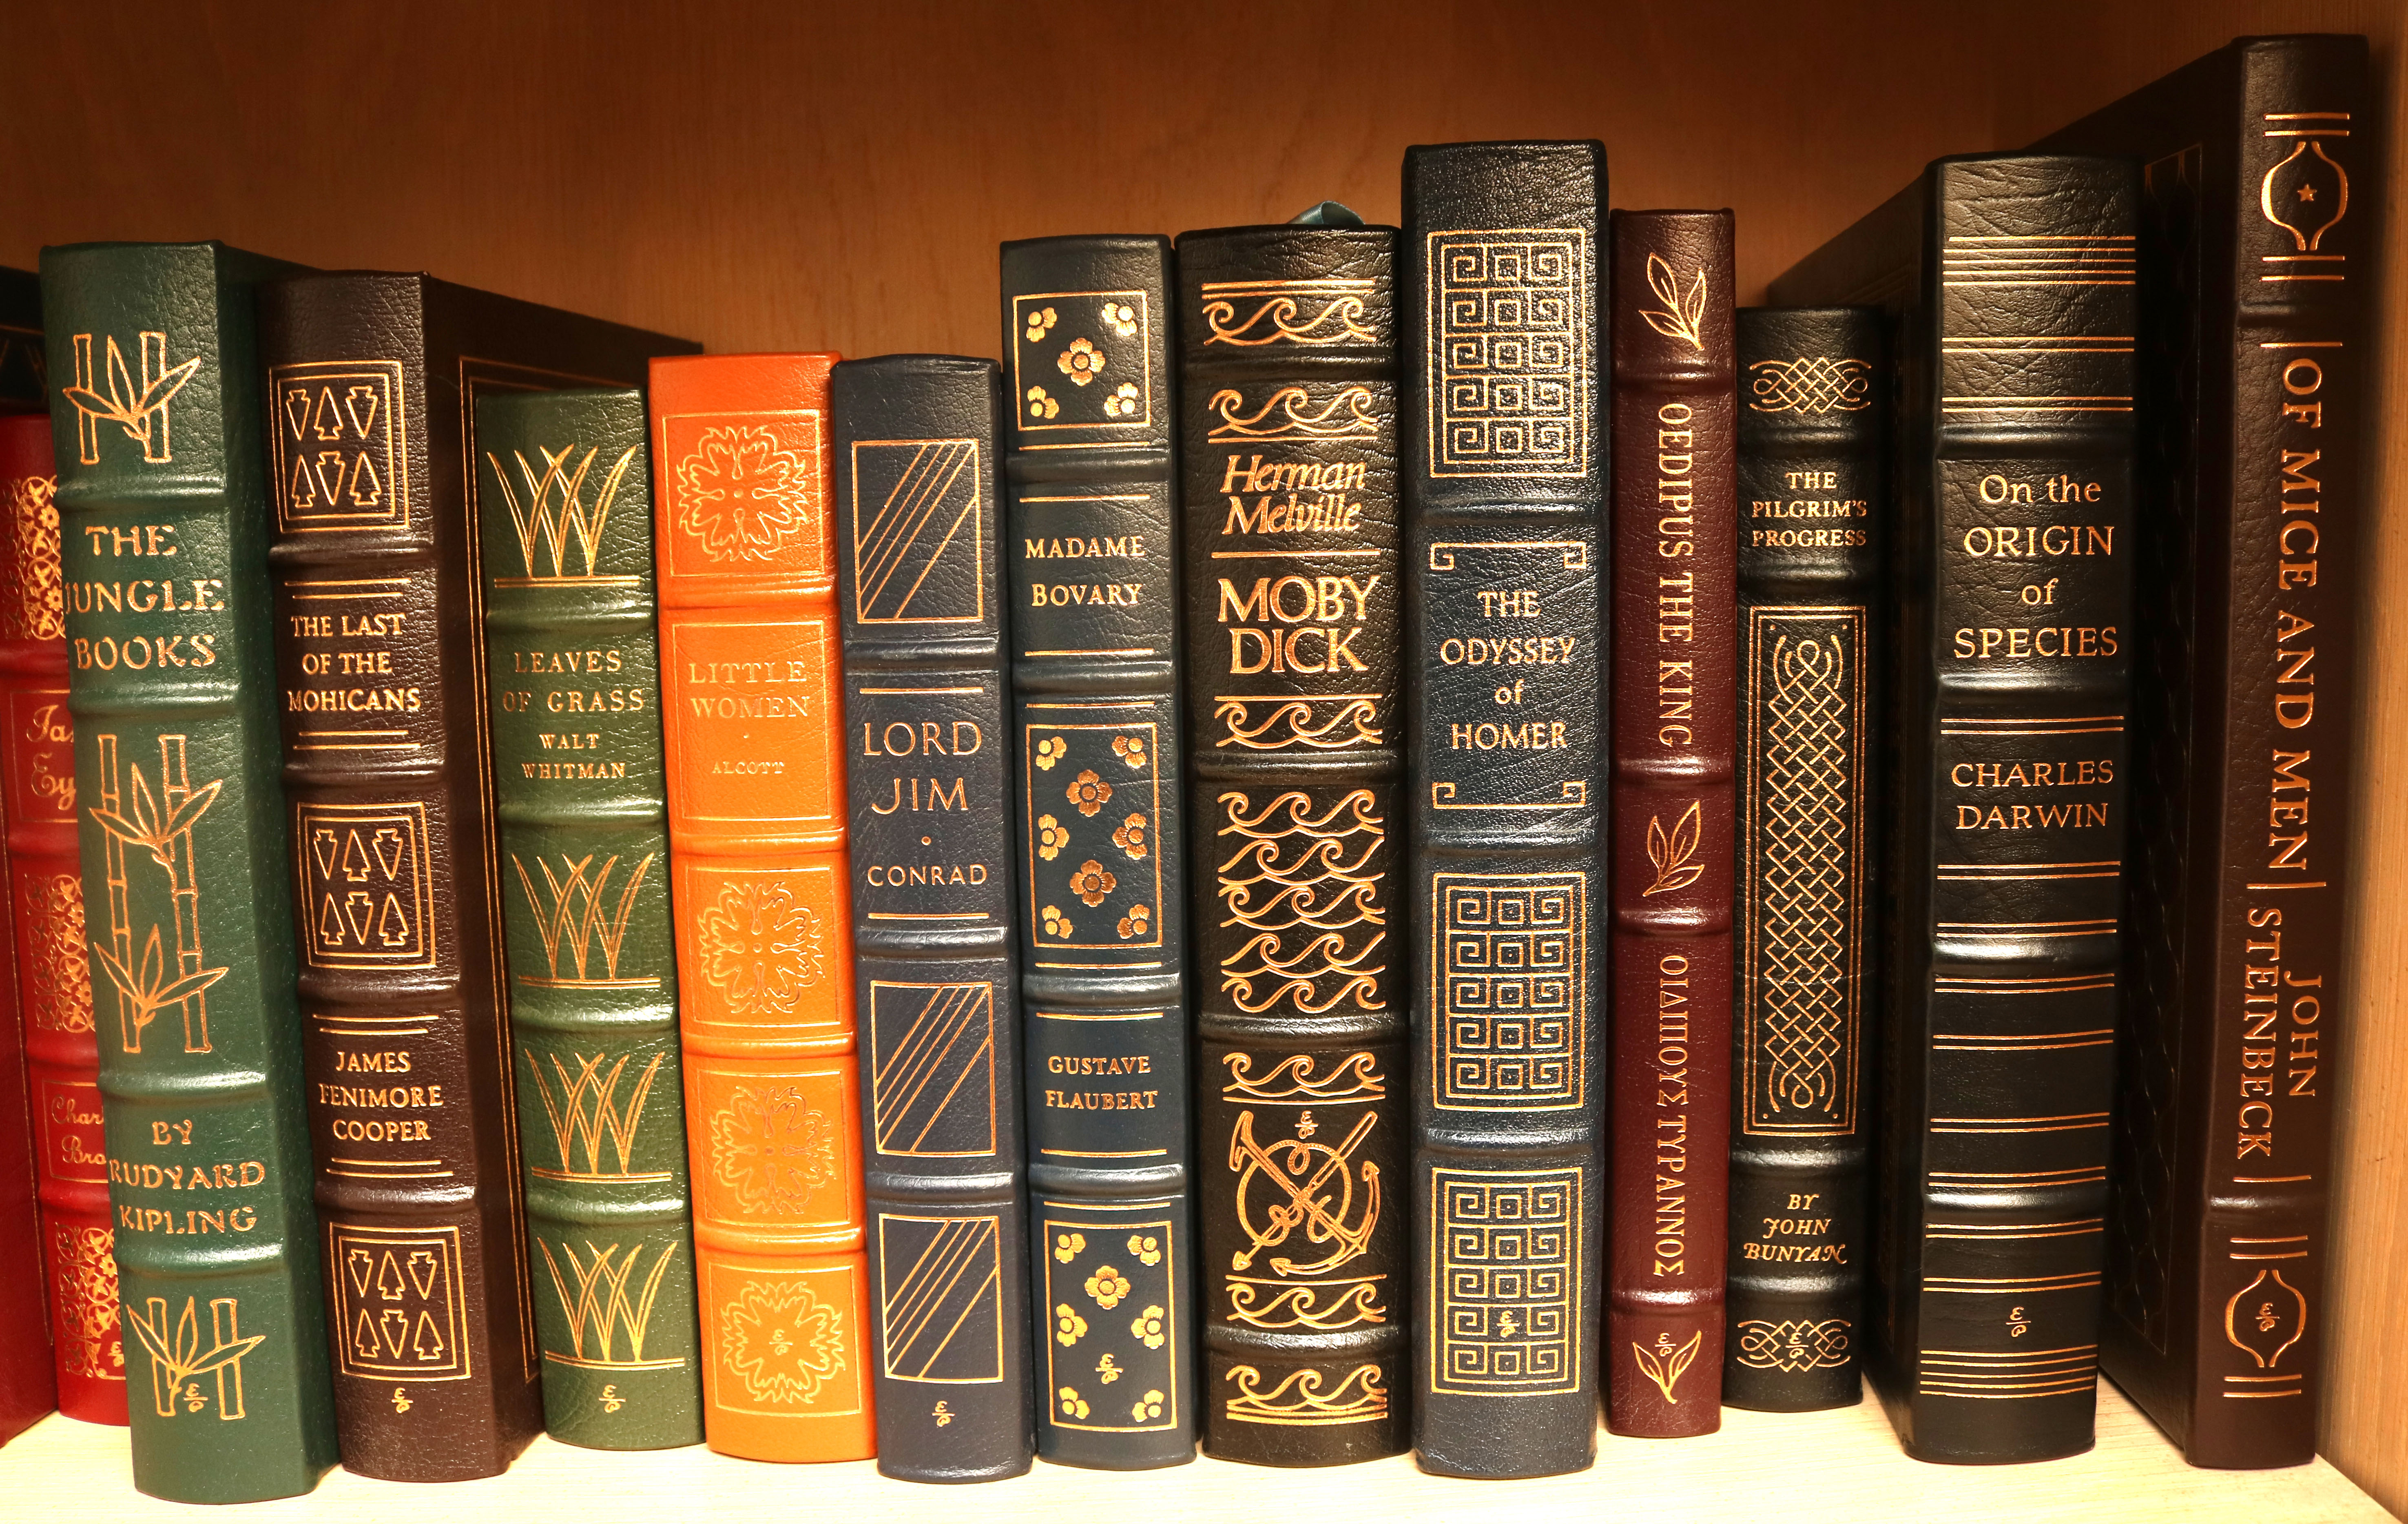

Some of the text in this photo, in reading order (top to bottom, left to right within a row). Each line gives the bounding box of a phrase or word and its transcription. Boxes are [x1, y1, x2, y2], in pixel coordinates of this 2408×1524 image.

[1220, 454, 1367, 493] Herman
[1785, 472, 1837, 490] THE
[1979, 474, 2101, 504] On the
[1222, 496, 1362, 535] Melville
[1752, 500, 1867, 518] PILGRIM'S
[86, 525, 177, 556] THE
[1025, 536, 1145, 559] MADAME
[1752, 529, 1867, 547] PROGRESS
[1963, 525, 2115, 556] ORIGIN
[1658, 403, 1694, 748] OEDIPUS THE KING
[65, 579, 224, 613] JUNGLE
[1031, 583, 1143, 607] BOVARY
[1217, 575, 1381, 623] MOBY
[1477, 590, 1542, 618] THE
[2021, 578, 2058, 605] of
[291, 612, 407, 638] THE LAST
[2268, 358, 2322, 870] OF MICE AND MEN
[75, 634, 216, 670] BOOKS
[1229, 627, 1369, 674] DICK
[1439, 637, 1576, 665] ODYSSEY
[1954, 626, 2117, 659] SPECIES
[302, 652, 392, 675] OF THE
[515, 650, 622, 673] LEAVES
[689, 661, 808, 683] LITTLE
[288, 688, 421, 711] MOHICANS
[503, 689, 644, 712] OF GRASS
[1494, 678, 1525, 705] of
[691, 696, 810, 718] WOMEN
[539, 734, 599, 749] WALT
[863, 721, 982, 756] LORD
[1451, 722, 1569, 750] HOMER
[522, 762, 625, 779] WHITMAN
[712, 762, 785, 775] ALCOTT
[1951, 760, 2114, 788] CHARLES
[871, 777, 969, 815] JIM
[1956, 803, 2108, 831] DARWIN
[868, 864, 988, 887] CONRAD
[2237, 907, 2283, 1160] STEINBECK
[2283, 969, 2322, 1097] JOHN
[336, 1051, 411, 1072] JAMES
[1047, 1055, 1151, 1076] GUSTAVE
[318, 1083, 444, 1108] FENIMORE
[1045, 1089, 1158, 1110] FLAUBERT
[152, 1119, 193, 1145] BY
[333, 1119, 431, 1141] COOPER
[109, 1159, 266, 1190] RUDYARD
[1787, 1194, 1819, 1210] BY
[119, 1206, 257, 1234] KIPLING
[1763, 1218, 1831, 1237] JOHN
[1744, 1243, 1848, 1265] BUNYAN
